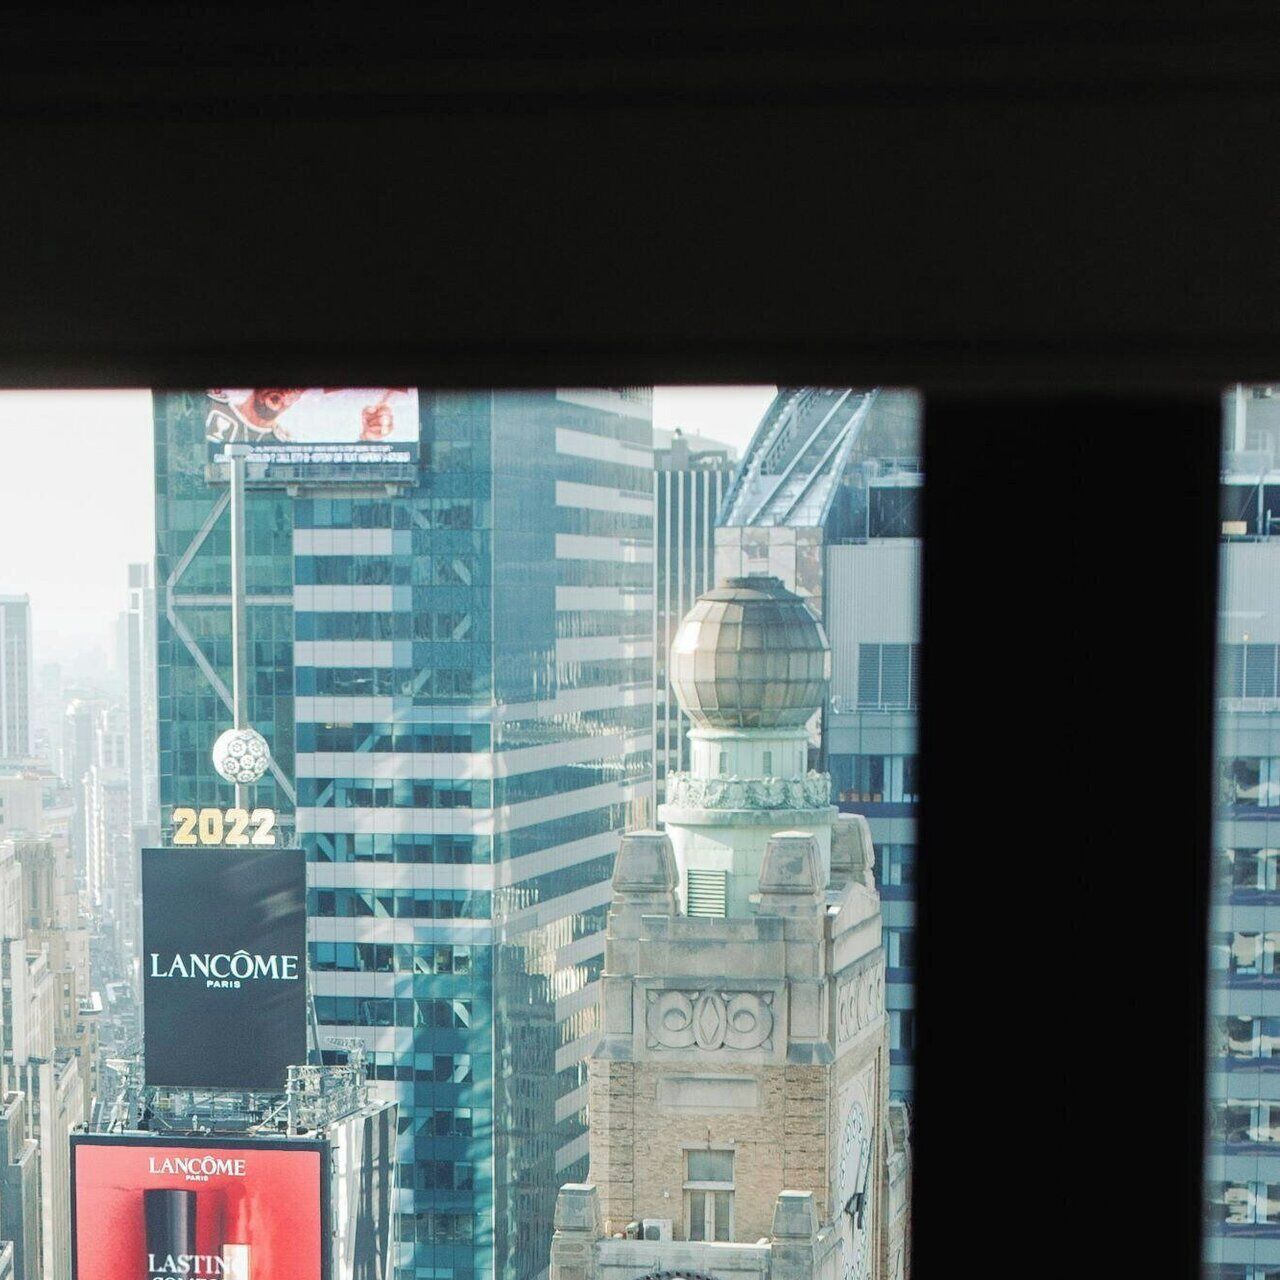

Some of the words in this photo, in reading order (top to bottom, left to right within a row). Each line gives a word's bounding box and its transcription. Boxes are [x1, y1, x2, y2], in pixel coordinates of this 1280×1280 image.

[173, 808, 276, 845] 2022
[150, 950, 298, 980] LANCÔME
[206, 980, 241, 989] PARIS
[149, 1155, 246, 1176] LANCÔME
[185, 1174, 209, 1182] PARIS
[148, 1254, 244, 1274] LASTING
